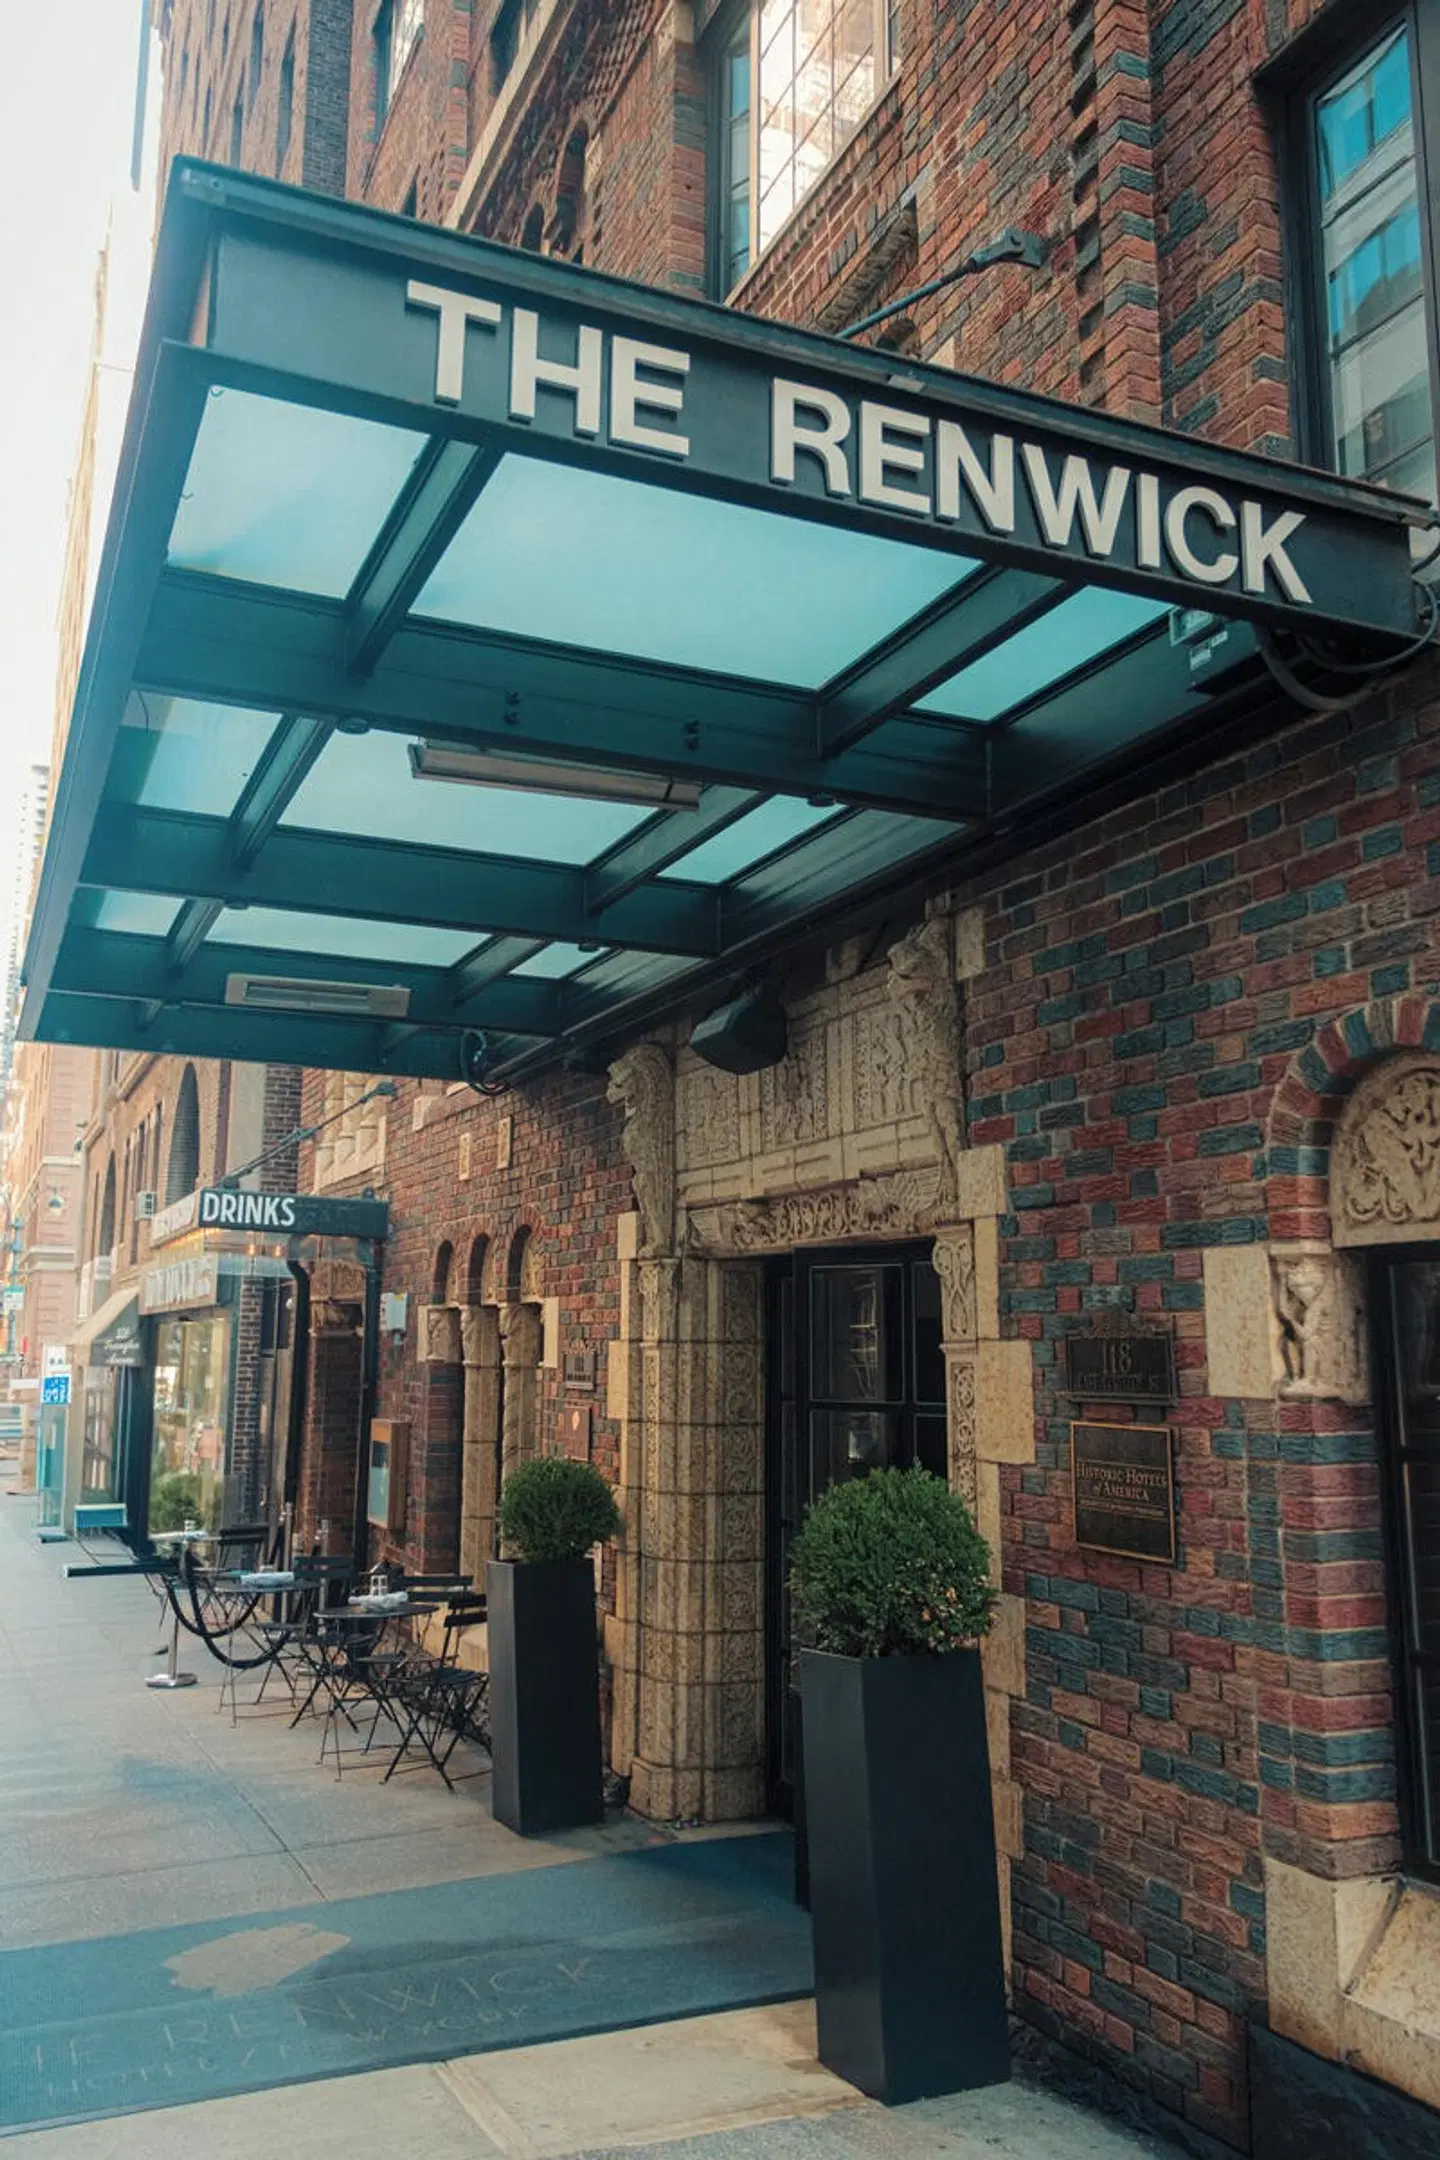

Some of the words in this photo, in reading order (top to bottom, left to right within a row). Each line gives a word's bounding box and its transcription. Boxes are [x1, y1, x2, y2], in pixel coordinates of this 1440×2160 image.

[405, 279, 692, 458] THE
[769, 376, 1314, 606] RENWICK
[202, 1192, 296, 1227] DRINKS
[1101, 1340, 1133, 1373] 118
